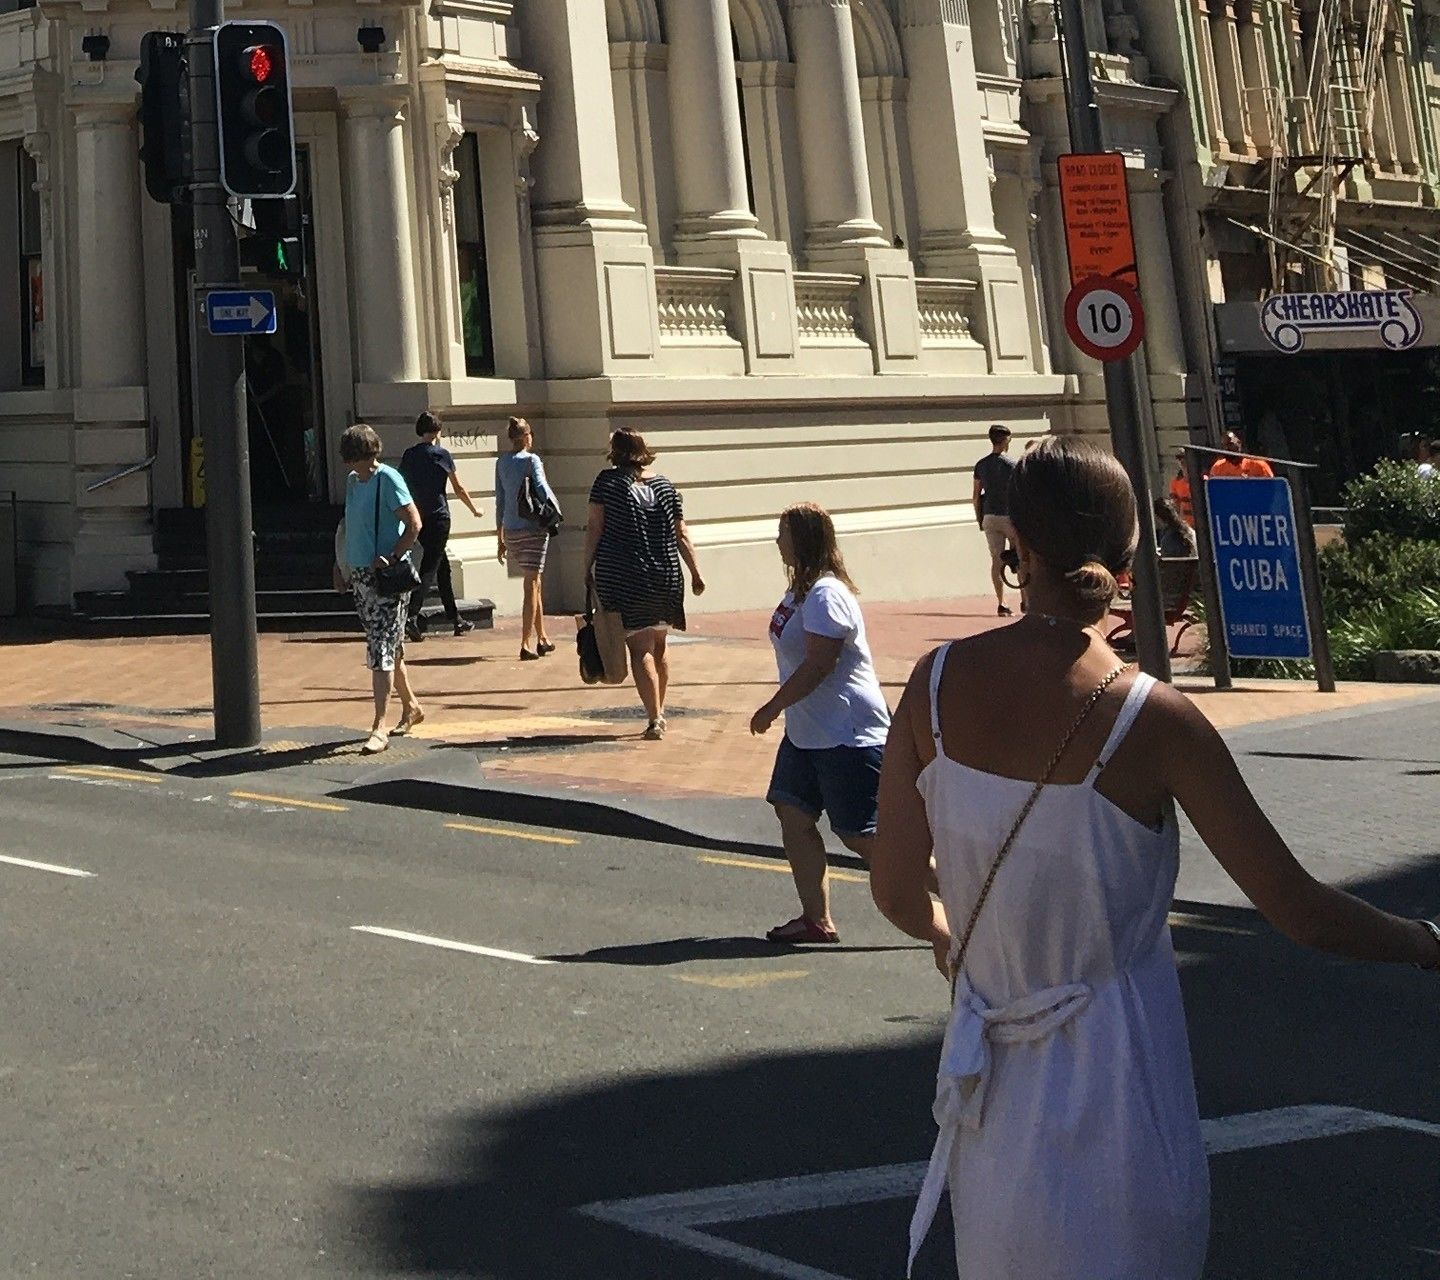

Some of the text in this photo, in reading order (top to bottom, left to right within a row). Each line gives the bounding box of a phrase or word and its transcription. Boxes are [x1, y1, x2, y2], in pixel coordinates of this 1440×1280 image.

[1087, 303, 1122, 335] 10
[1268, 289, 1418, 323] CHEAPSKATES
[1216, 514, 1291, 547] LOWER
[1229, 557, 1289, 591] CUBA
[1230, 624, 1304, 639] SHARED SPACE
